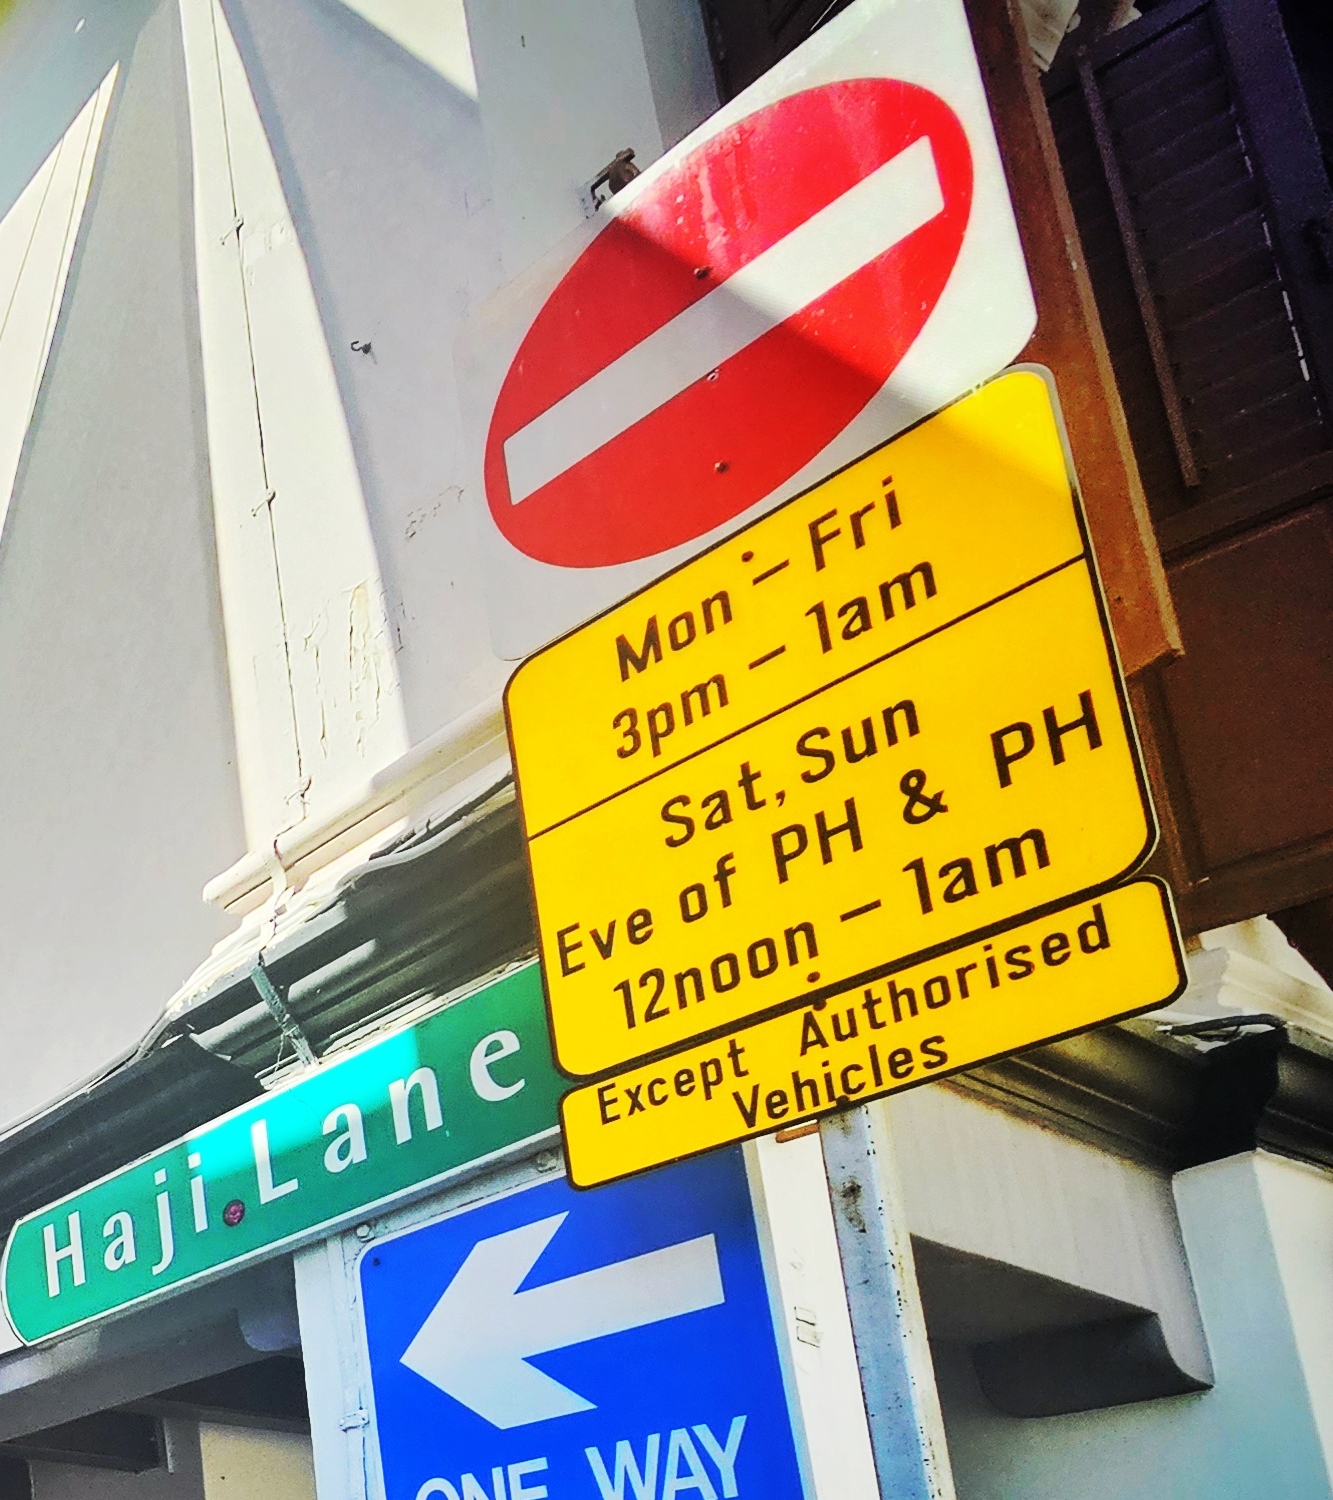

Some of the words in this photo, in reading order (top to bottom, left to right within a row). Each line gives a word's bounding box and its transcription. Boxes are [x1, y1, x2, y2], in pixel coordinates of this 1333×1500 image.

[612, 673, 729, 759] 3pm
[804, 559, 937, 655] 1am
[615, 589, 733, 682] Mon
[808, 475, 903, 572] Fri
[555, 907, 654, 977] Eve
[679, 851, 736, 924] of
[770, 797, 864, 885] PH
[899, 768, 949, 825] &
[990, 688, 1104, 789] PH
[613, 920, 819, 1030] 12noon
[902, 827, 1052, 916] 1am
[596, 1038, 749, 1126] Except
[798, 902, 1112, 1058] Authorised
[732, 1034, 950, 1130] Vehicles
[42, 1151, 210, 1298] Haji
[249, 1029, 526, 1206] Lane
